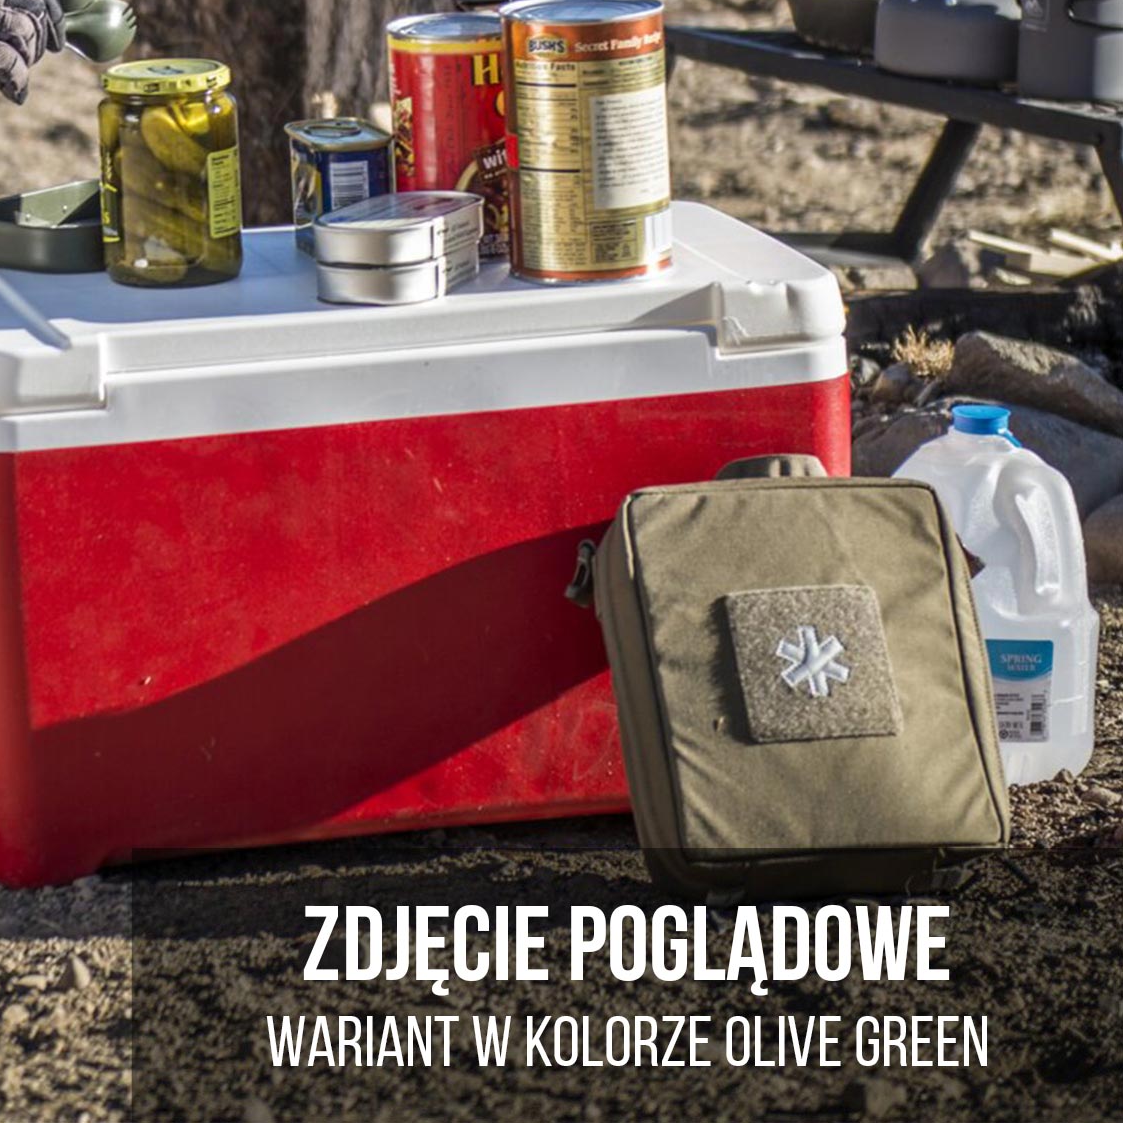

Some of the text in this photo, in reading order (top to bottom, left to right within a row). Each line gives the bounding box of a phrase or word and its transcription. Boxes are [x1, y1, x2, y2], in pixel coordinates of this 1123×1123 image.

[575, 40, 609, 52] Secret
[610, 36, 643, 50] Family
[1000, 653, 1043, 664] SPRING
